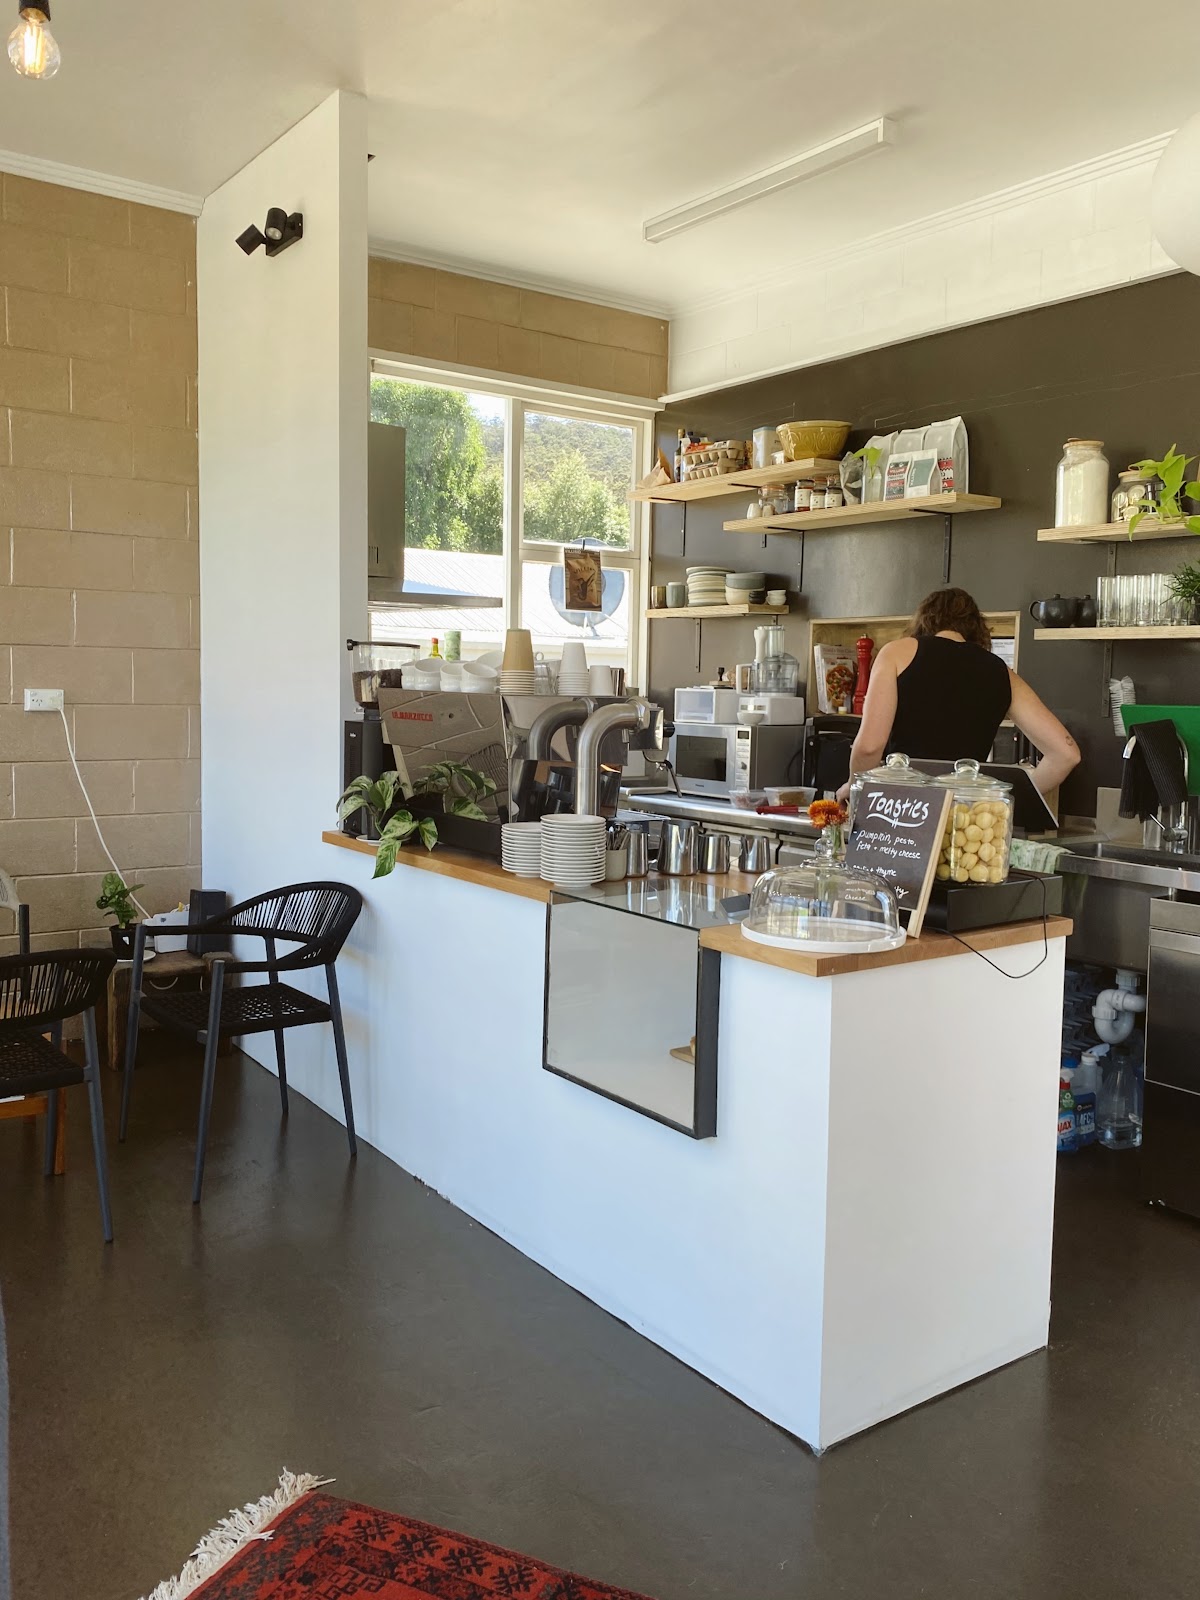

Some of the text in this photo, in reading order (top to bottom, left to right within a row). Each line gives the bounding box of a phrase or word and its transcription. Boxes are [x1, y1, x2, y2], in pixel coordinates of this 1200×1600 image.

[867, 791, 930, 821] Toasties
[856, 830, 892, 844] pumpkin,
[856, 841, 871, 851] feta
[879, 846, 898, 858] melty
[898, 850, 921, 859] cheese
[876, 866, 897, 878] thyme
